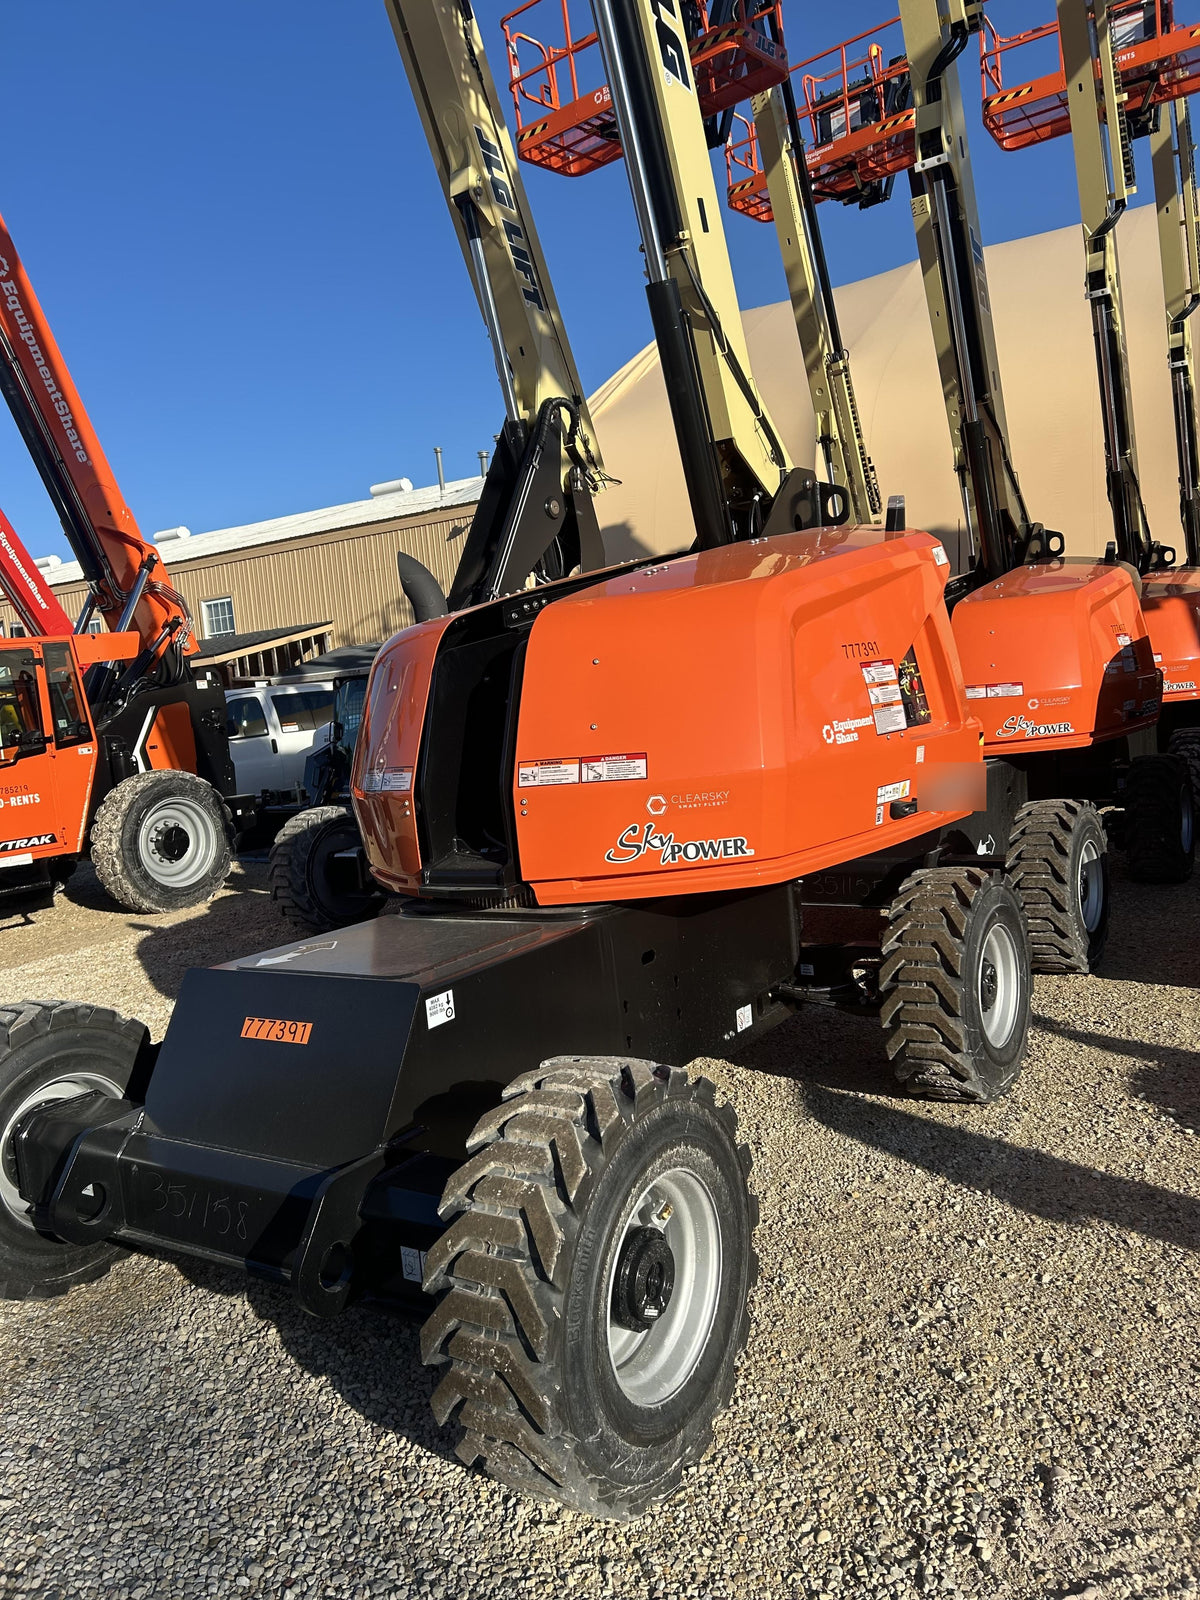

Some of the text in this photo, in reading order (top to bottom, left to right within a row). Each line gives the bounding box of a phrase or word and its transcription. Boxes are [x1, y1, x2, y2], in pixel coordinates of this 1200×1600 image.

[755, 34, 777, 59] JLG
[1115, 51, 1136, 63] ENTS
[473, 123, 545, 313] JLG LIFT
[1, 279, 88, 464] EquipmentShare
[0, 531, 47, 610] EquipmentShare
[841, 641, 880, 659] 777391
[832, 714, 874, 733] Equipment
[835, 732, 859, 745] Share
[671, 790, 730, 804] CLEARSKY
[244, 1018, 307, 1042] 777391
[567, 1228, 596, 1343] Blacksmith
